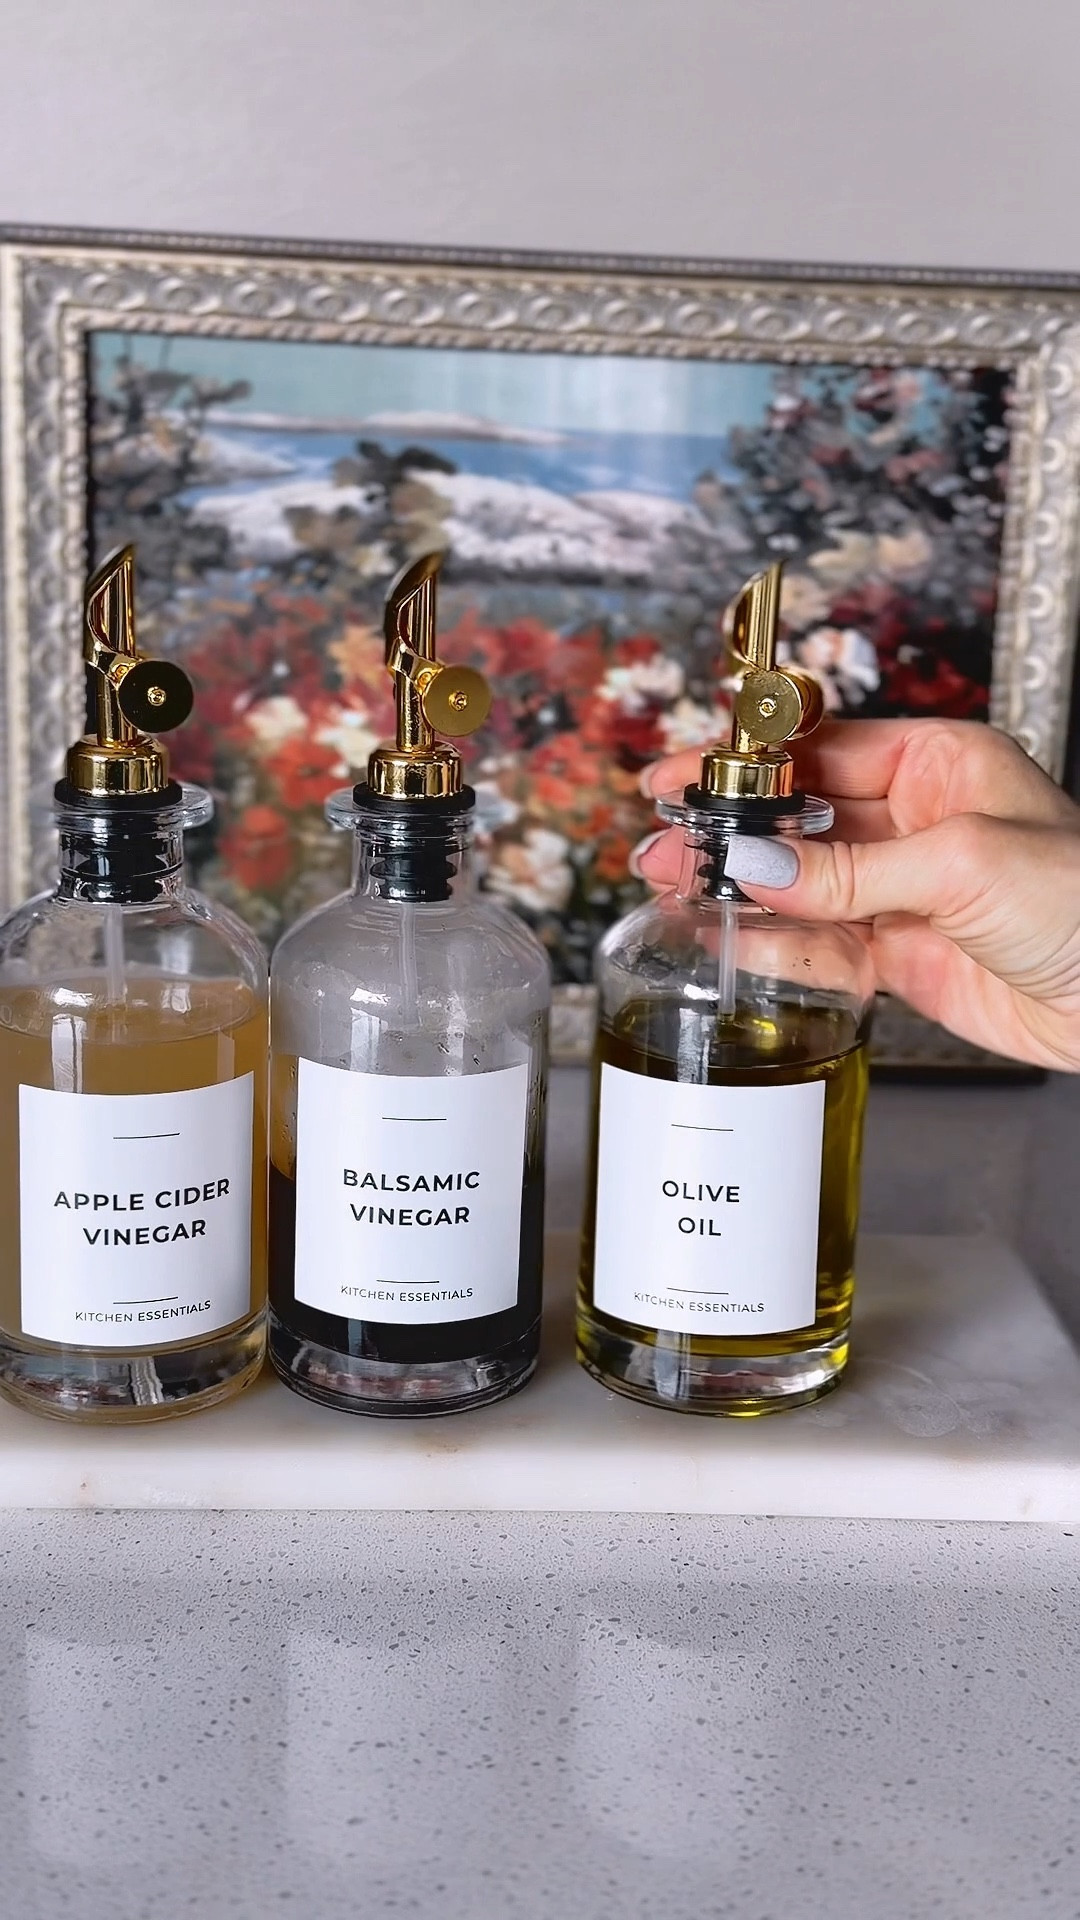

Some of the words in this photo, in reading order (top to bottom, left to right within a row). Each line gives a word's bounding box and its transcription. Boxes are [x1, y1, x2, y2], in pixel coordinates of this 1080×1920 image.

[343, 1168, 481, 1193] BALSAMIC
[661, 1180, 741, 1203] OLIVE
[53, 1190, 145, 1212] APPLE
[154, 1178, 230, 1209] CIDER
[349, 1202, 471, 1227] VINEGAR
[82, 1219, 207, 1247] VINEGAR
[677, 1216, 722, 1237] OIL
[340, 1285, 394, 1301] KITCHEN
[399, 1287, 474, 1302] ESSENTIALS
[634, 1291, 685, 1310] KITCHEN
[688, 1301, 765, 1313] ESSENTIALS
[75, 1310, 133, 1323] KITCHEN
[137, 1300, 212, 1322] ESSENTIALS
